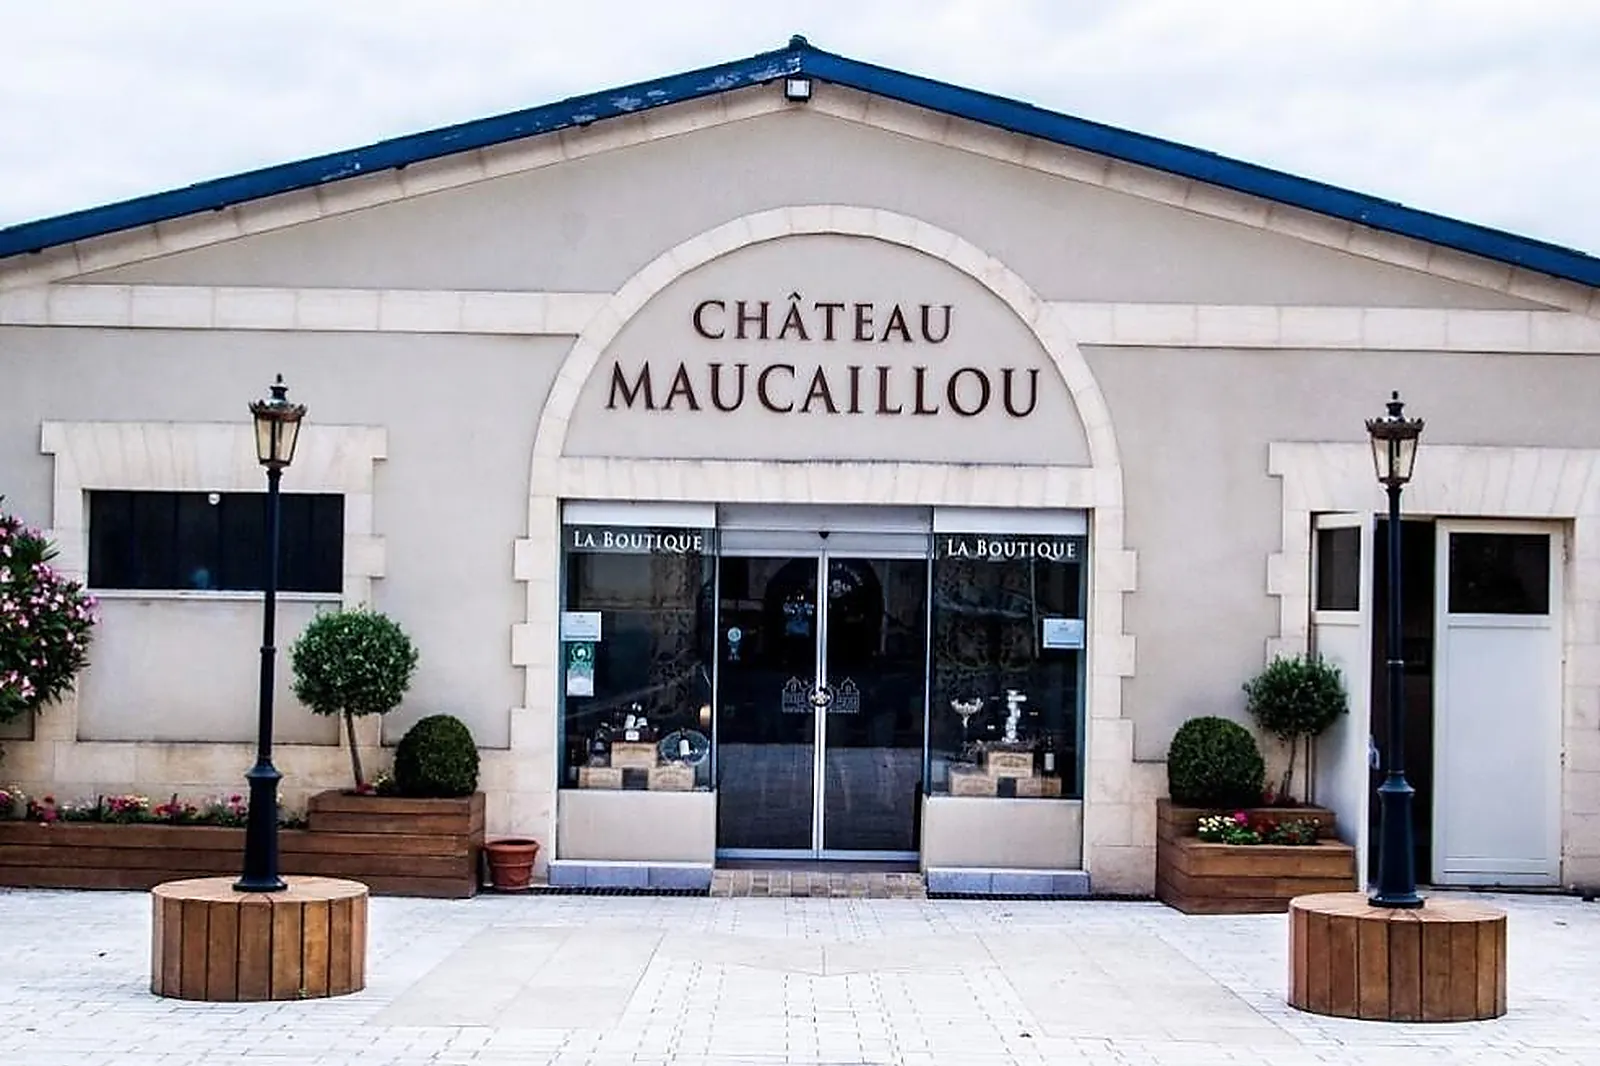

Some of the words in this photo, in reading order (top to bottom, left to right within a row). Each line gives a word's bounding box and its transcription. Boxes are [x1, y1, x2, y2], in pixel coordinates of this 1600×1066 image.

[693, 292, 953, 345] CHÂTEAU
[606, 360, 1041, 418] MAUCAILLOU
[603, 530, 703, 554] BOUTIQUE
[977, 538, 1076, 561] BOUTIQUE
